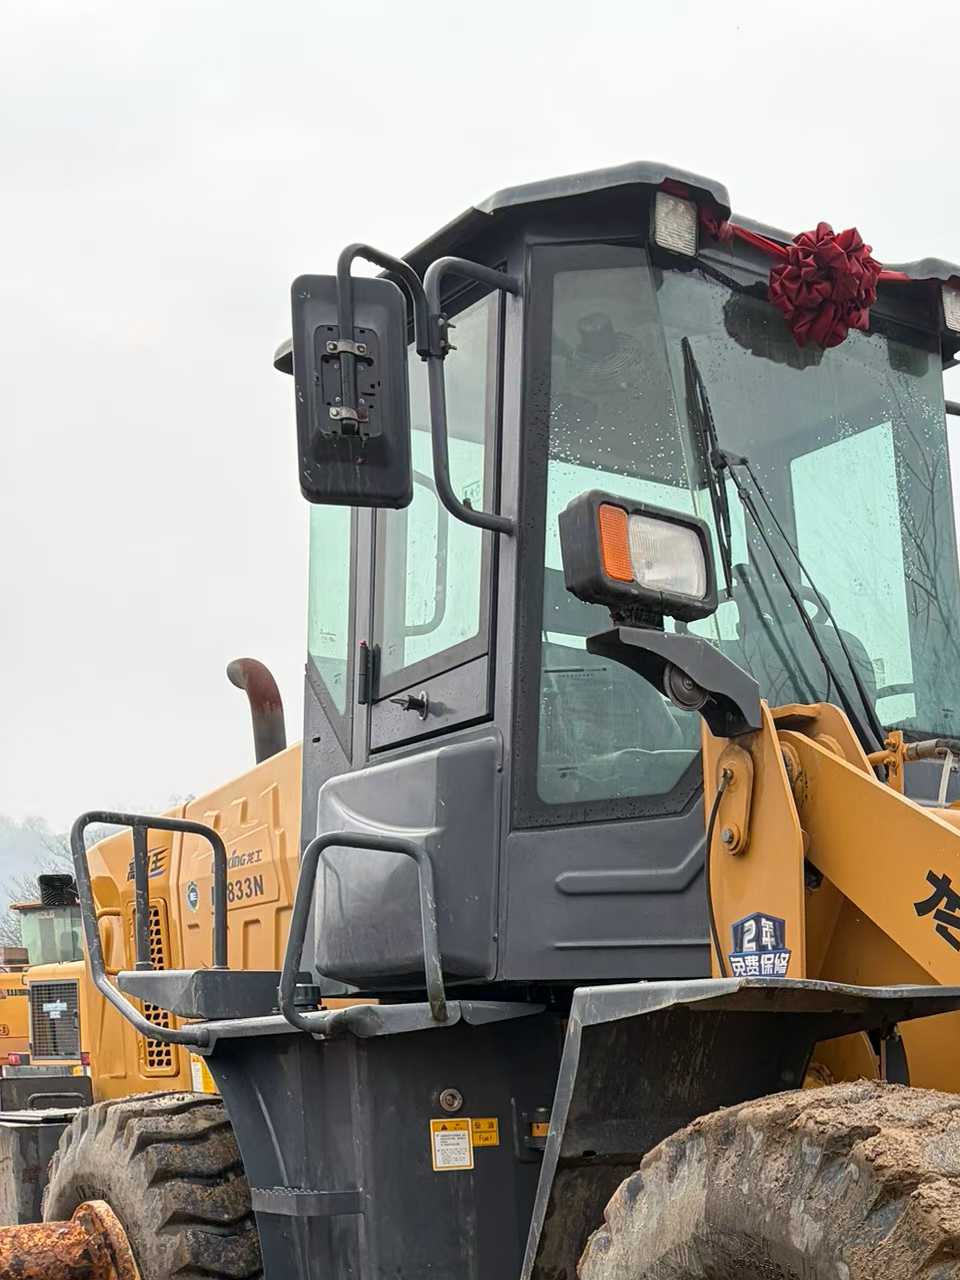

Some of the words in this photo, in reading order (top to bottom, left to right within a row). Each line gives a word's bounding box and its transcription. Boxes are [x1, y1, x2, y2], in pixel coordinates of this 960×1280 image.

[211, 874, 264, 907] 833N
[742, 917, 776, 952] 2年
[730, 952, 790, 977] 免费保修
